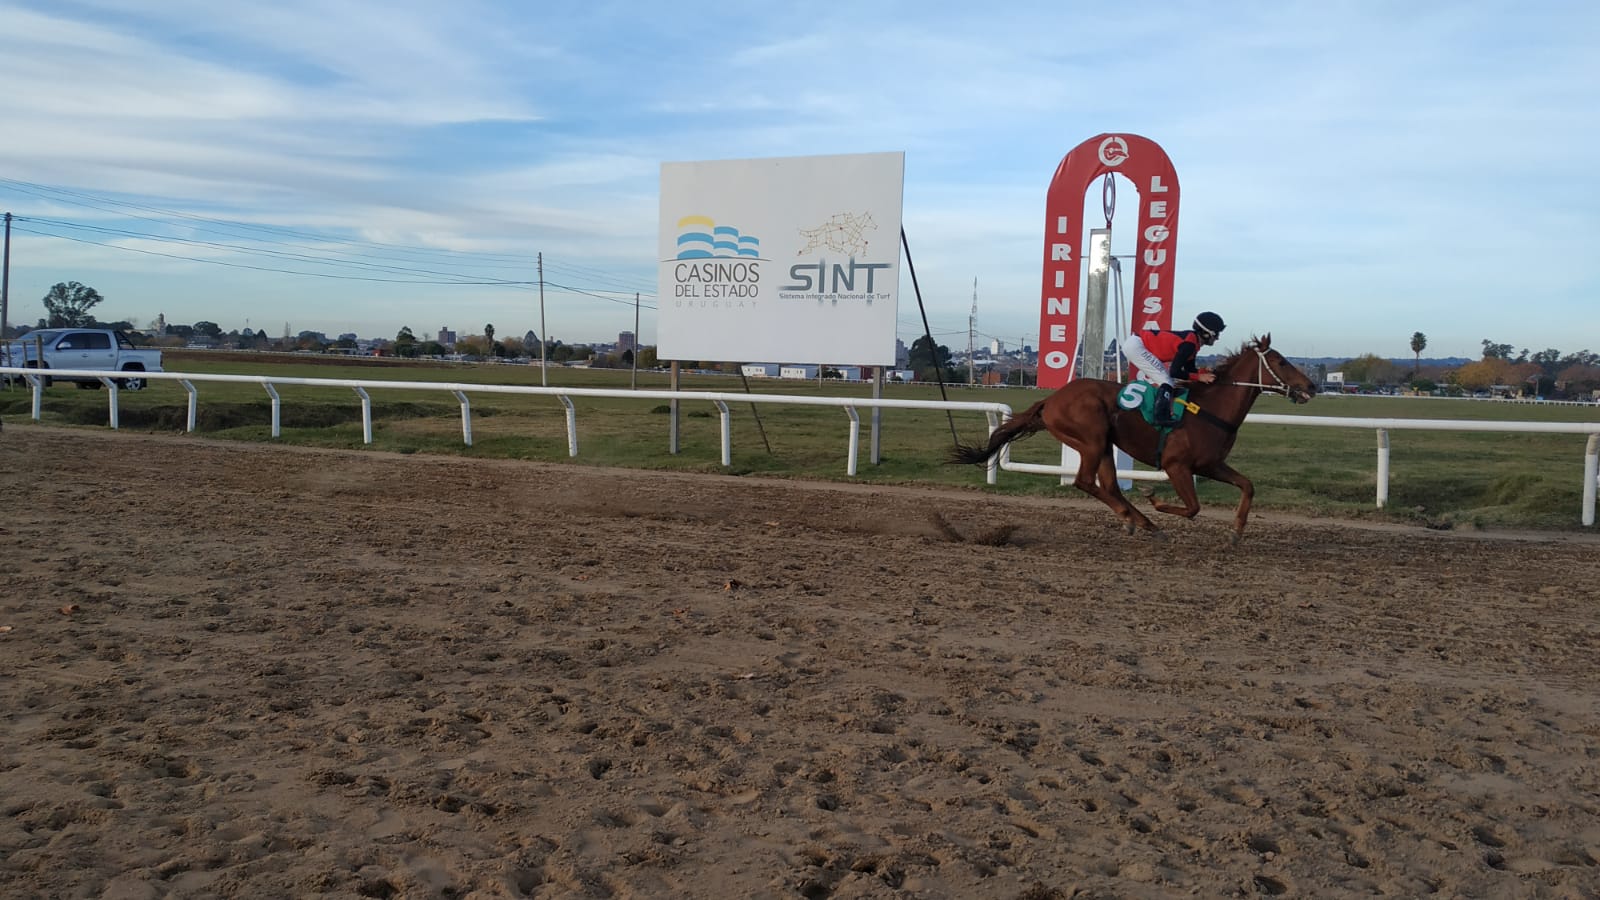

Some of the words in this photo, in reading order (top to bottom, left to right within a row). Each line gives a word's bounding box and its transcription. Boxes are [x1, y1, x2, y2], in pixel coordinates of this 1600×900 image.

[674, 262, 760, 283] CASINOS
[778, 258, 892, 295] SINT
[1137, 175, 1169, 386] LEGUISA
[674, 284, 700, 298] DEL
[703, 284, 759, 298] ESTADO
[778, 292, 805, 300] Sistema
[837, 292, 866, 300] Nacional
[876, 292, 891, 300] Turf
[1044, 216, 1072, 369] IRINEO
[675, 300, 758, 308] URUGUAY
[1119, 383, 1148, 409] 5
